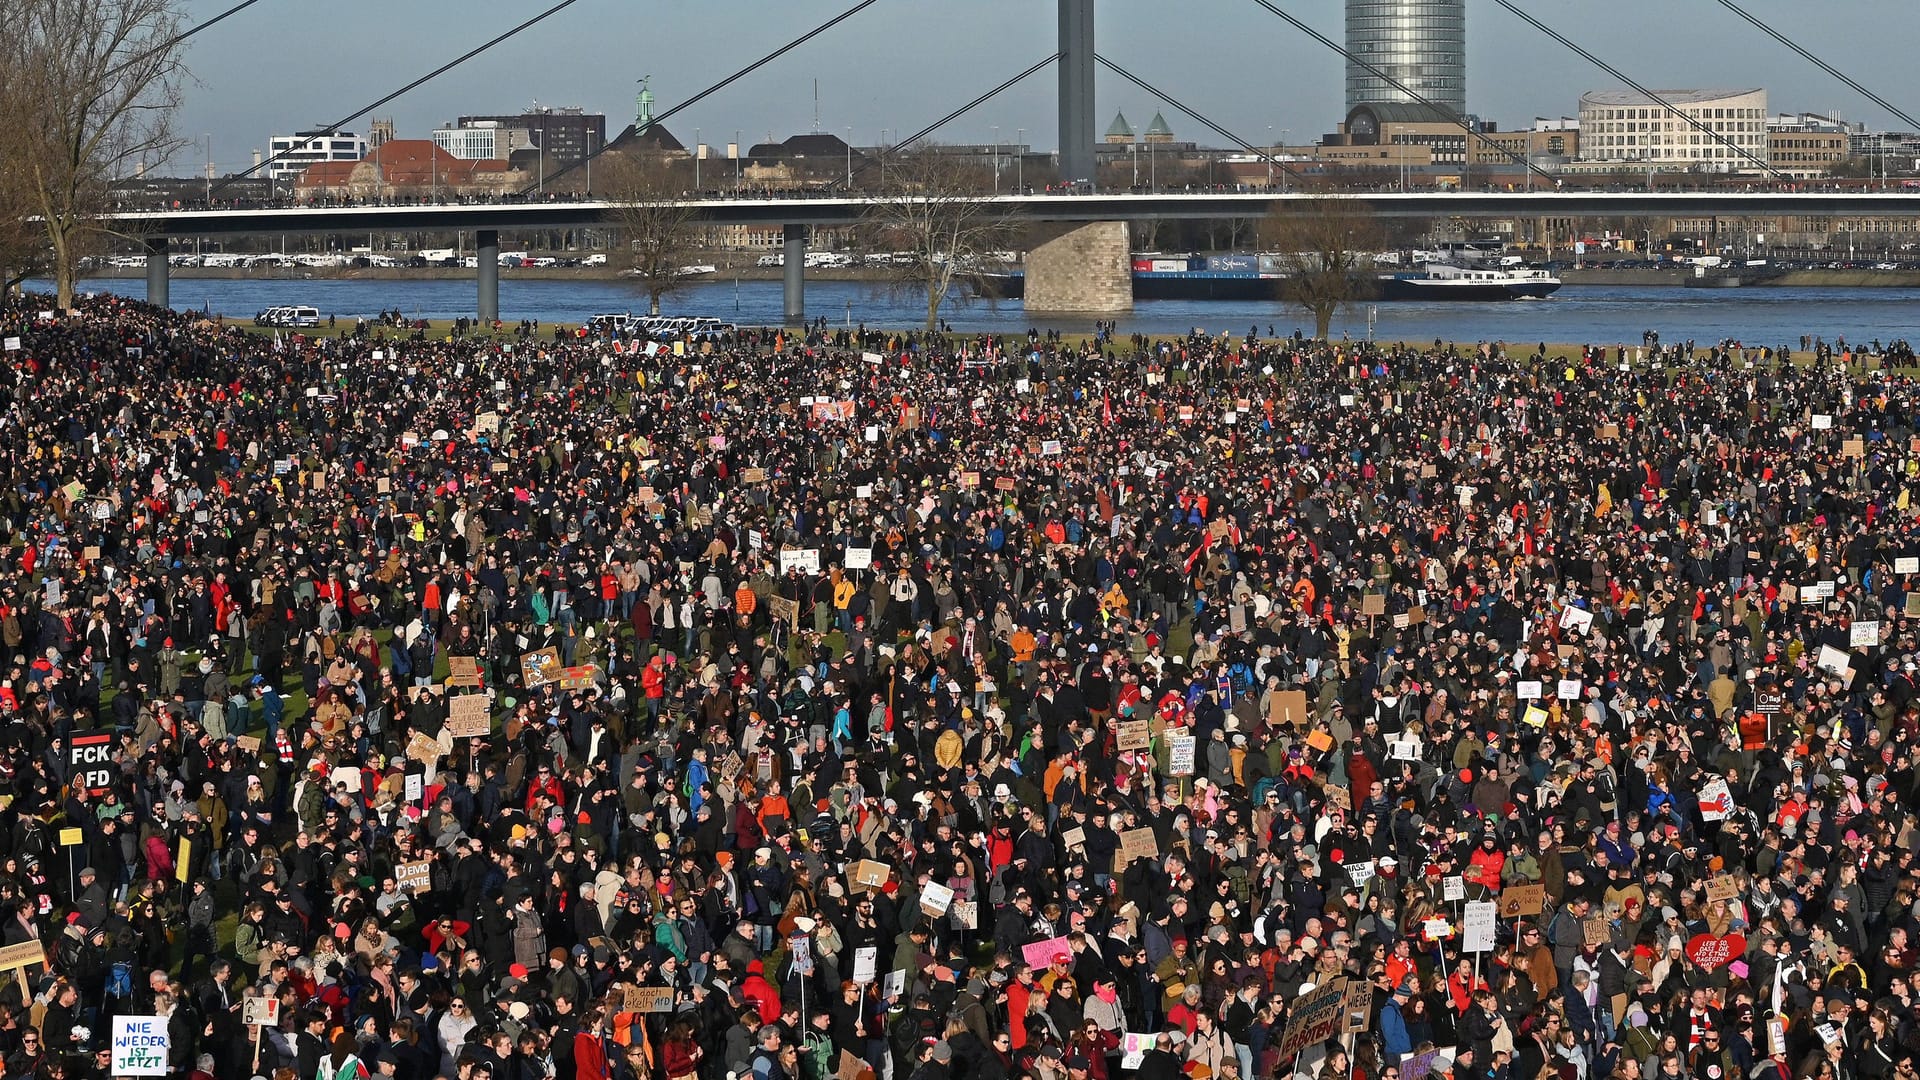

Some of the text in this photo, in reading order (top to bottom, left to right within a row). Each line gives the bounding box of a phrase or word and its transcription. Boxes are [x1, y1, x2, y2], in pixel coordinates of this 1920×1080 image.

[72, 745, 110, 765] FCK
[395, 863, 430, 880] DEMO
[396, 876, 430, 891] KRATIE
[1355, 982, 1367, 994] NIE
[1347, 993, 1372, 1008] WIEDER
[126, 1022, 152, 1034] NIE
[116, 1035, 167, 1048] WIEDER
[130, 1047, 149, 1057] IST
[118, 1056, 163, 1070] JETZT
